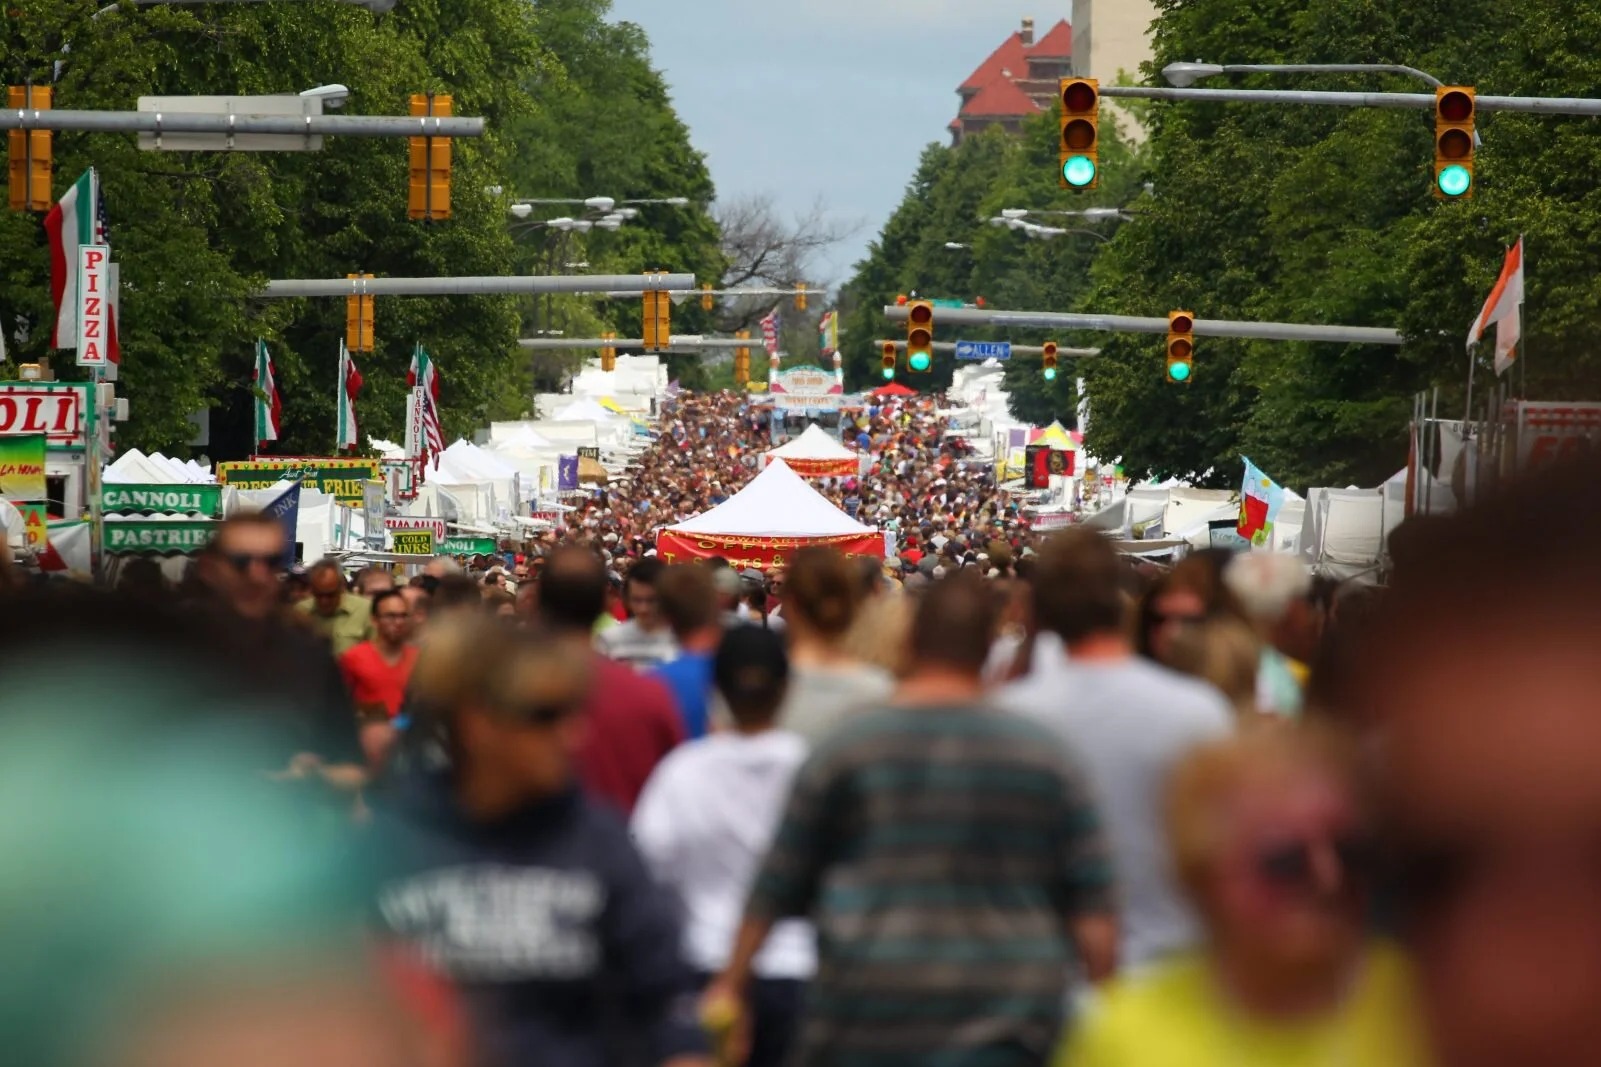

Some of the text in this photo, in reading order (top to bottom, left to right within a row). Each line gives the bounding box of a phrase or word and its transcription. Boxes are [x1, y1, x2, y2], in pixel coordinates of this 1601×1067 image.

[83, 251, 103, 360] PIZZA
[413, 389, 421, 452] CANNOLI
[103, 491, 201, 508] CANNOLI
